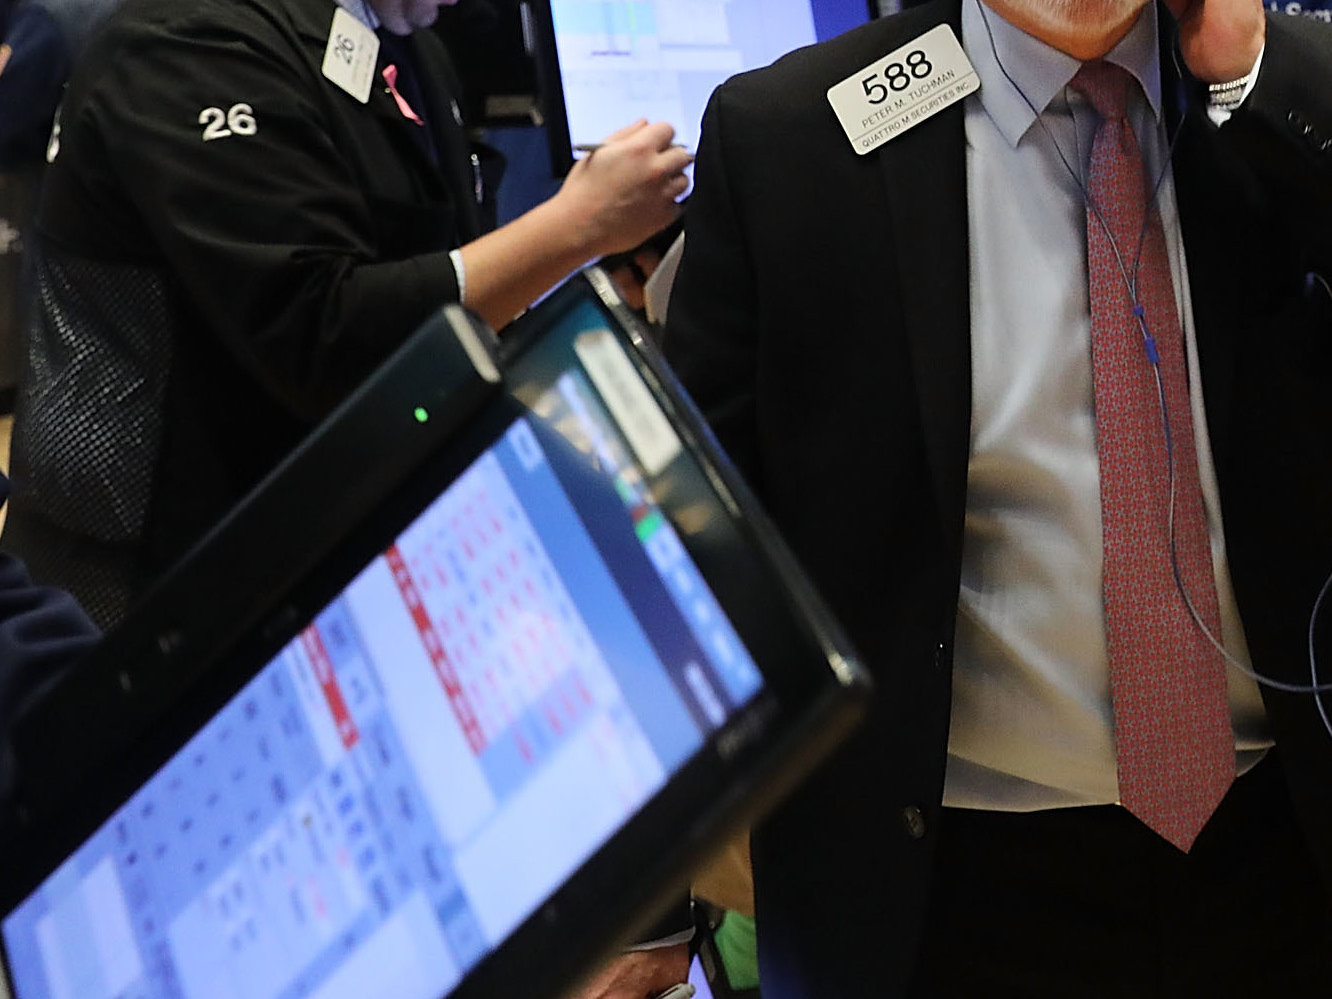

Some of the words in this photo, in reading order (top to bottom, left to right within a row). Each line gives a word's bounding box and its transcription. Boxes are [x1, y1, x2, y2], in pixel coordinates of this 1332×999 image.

[862, 50, 932, 104] 588
[862, 105, 893, 128] PETER
[909, 70, 955, 100] TUCHMAN
[199, 103, 257, 142] 26
[862, 122, 900, 147] QUATTRO
[912, 92, 955, 119] SECURITIES
